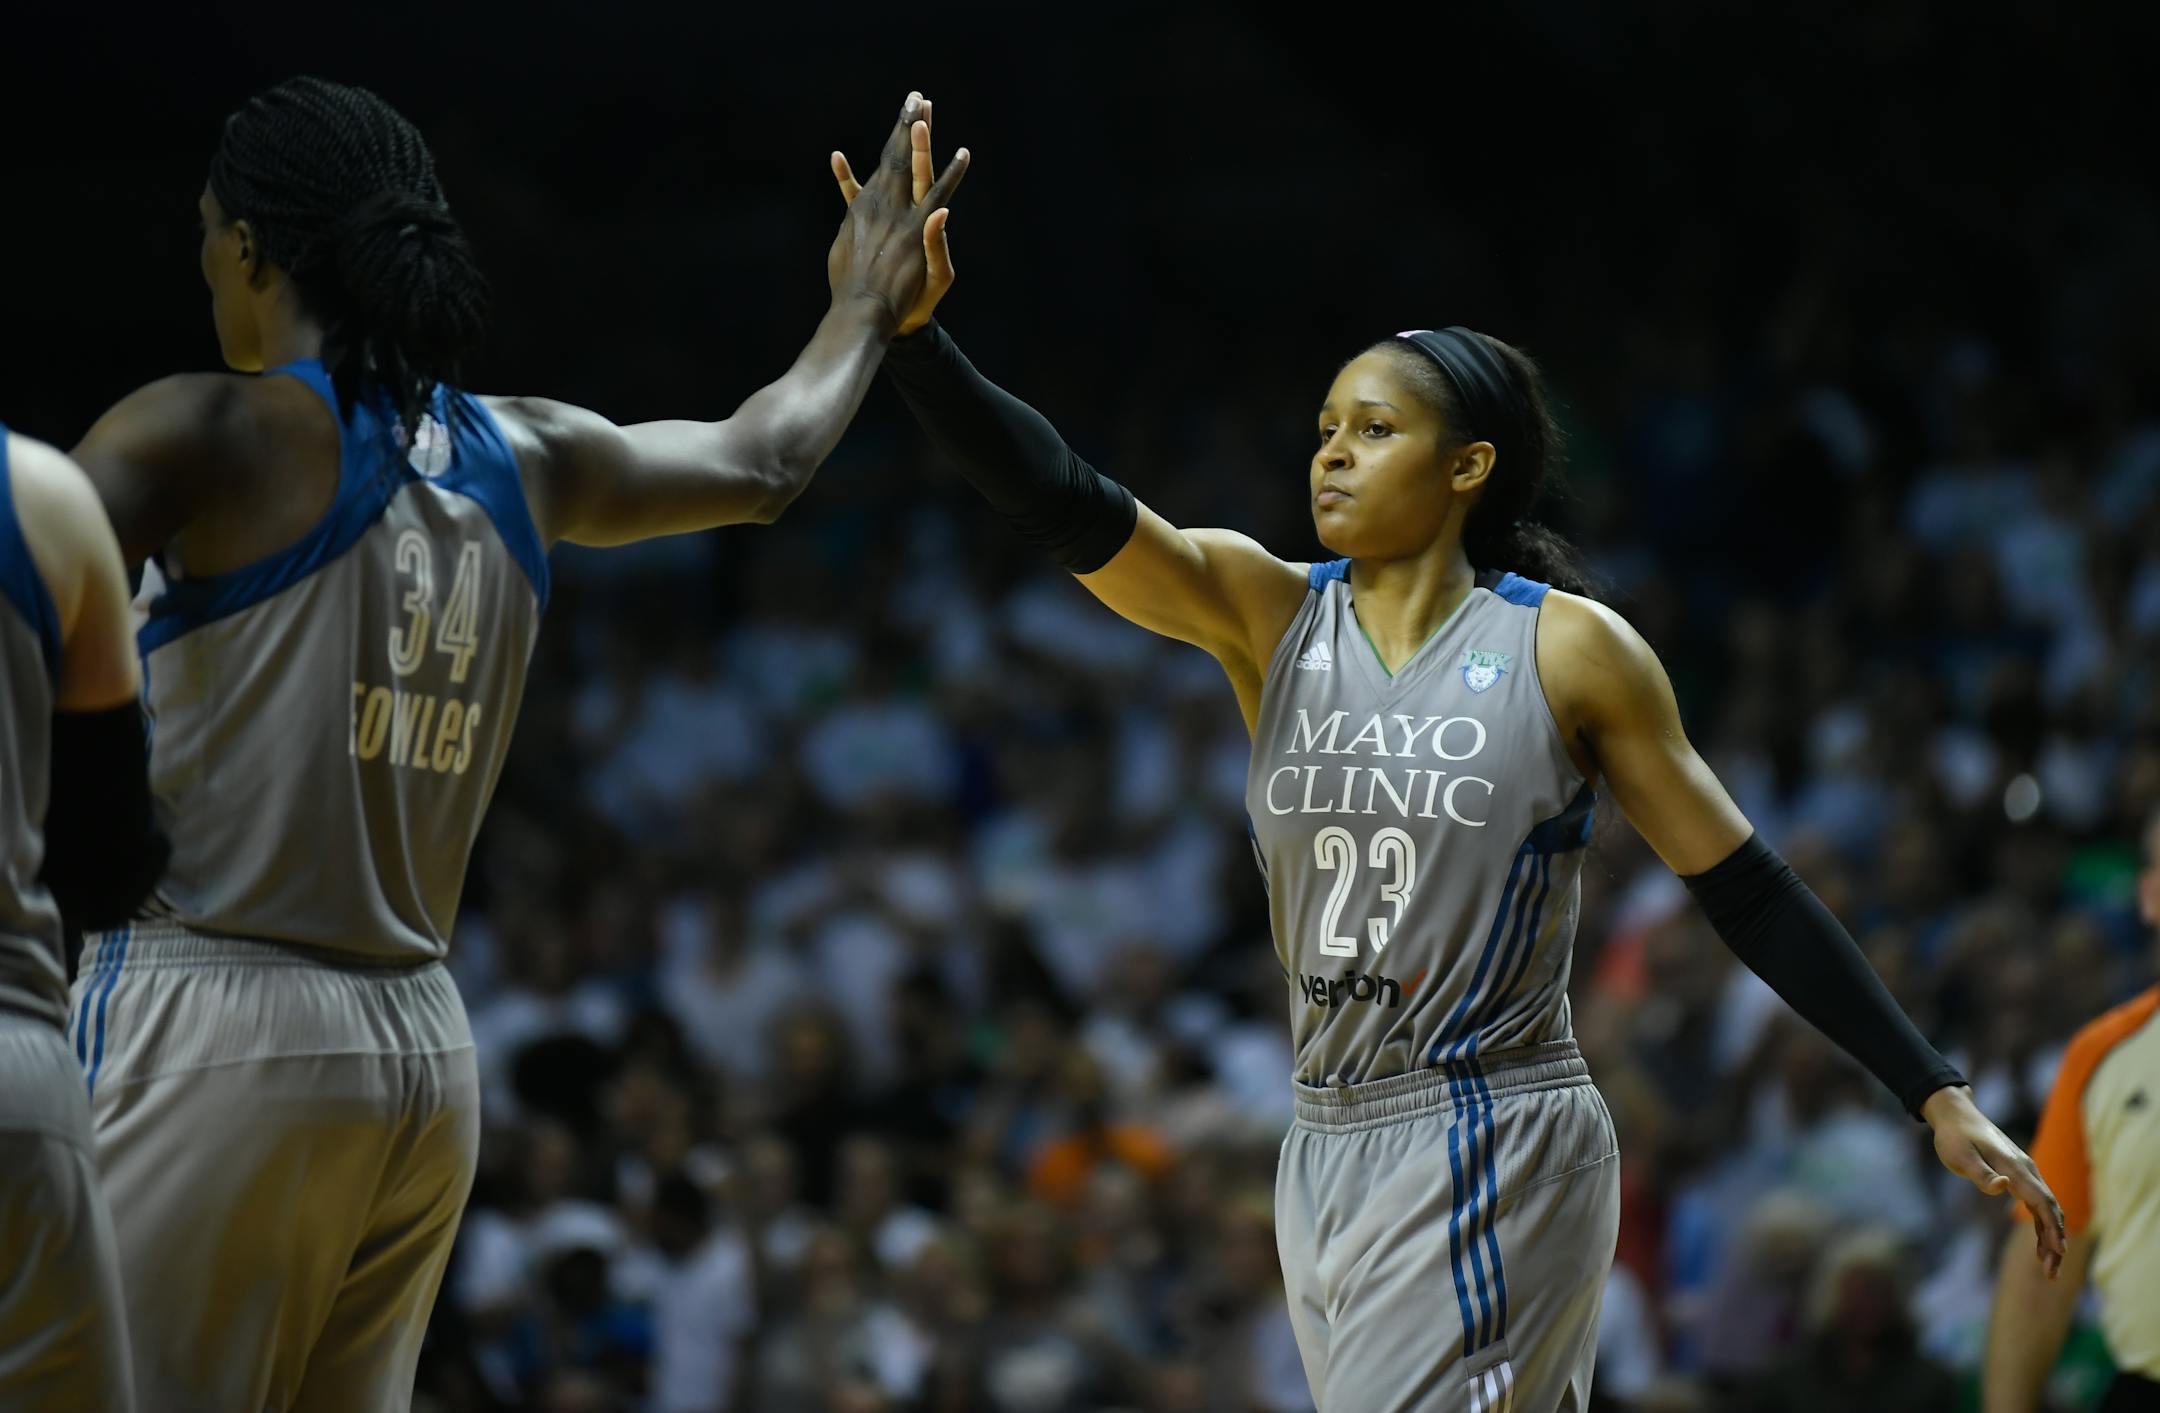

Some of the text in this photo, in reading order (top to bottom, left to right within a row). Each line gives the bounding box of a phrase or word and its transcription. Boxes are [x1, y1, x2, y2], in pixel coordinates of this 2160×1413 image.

[388, 529, 482, 683] 34
[1295, 659, 1331, 671] adida
[1286, 708, 1487, 761] MAYO
[1265, 765, 1495, 827] CLINIC
[1314, 826, 1417, 959] 23
[1300, 970, 1401, 1009] verion
